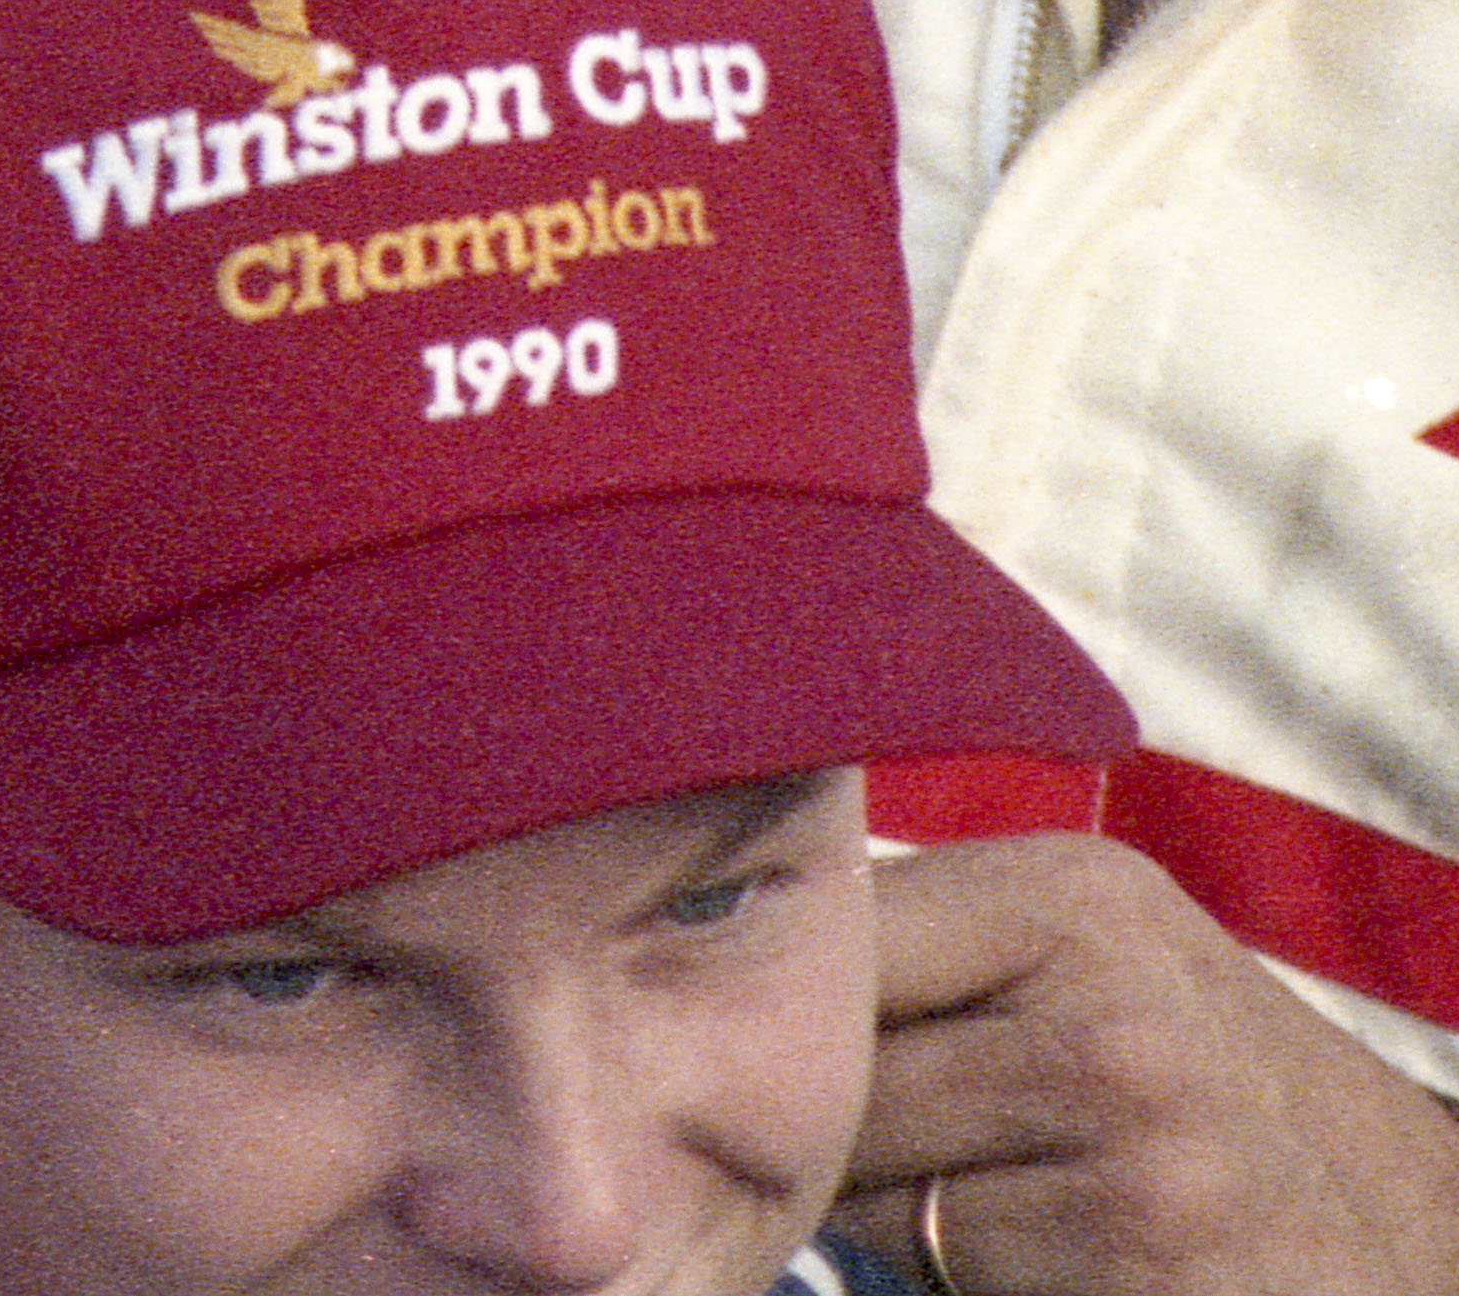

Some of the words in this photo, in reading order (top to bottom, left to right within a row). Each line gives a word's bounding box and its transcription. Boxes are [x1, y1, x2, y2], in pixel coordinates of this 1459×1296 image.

[41, 54, 552, 241] Winston
[568, 28, 768, 143] Cup
[215, 179, 713, 322] Champion
[421, 317, 619, 421] 1990
